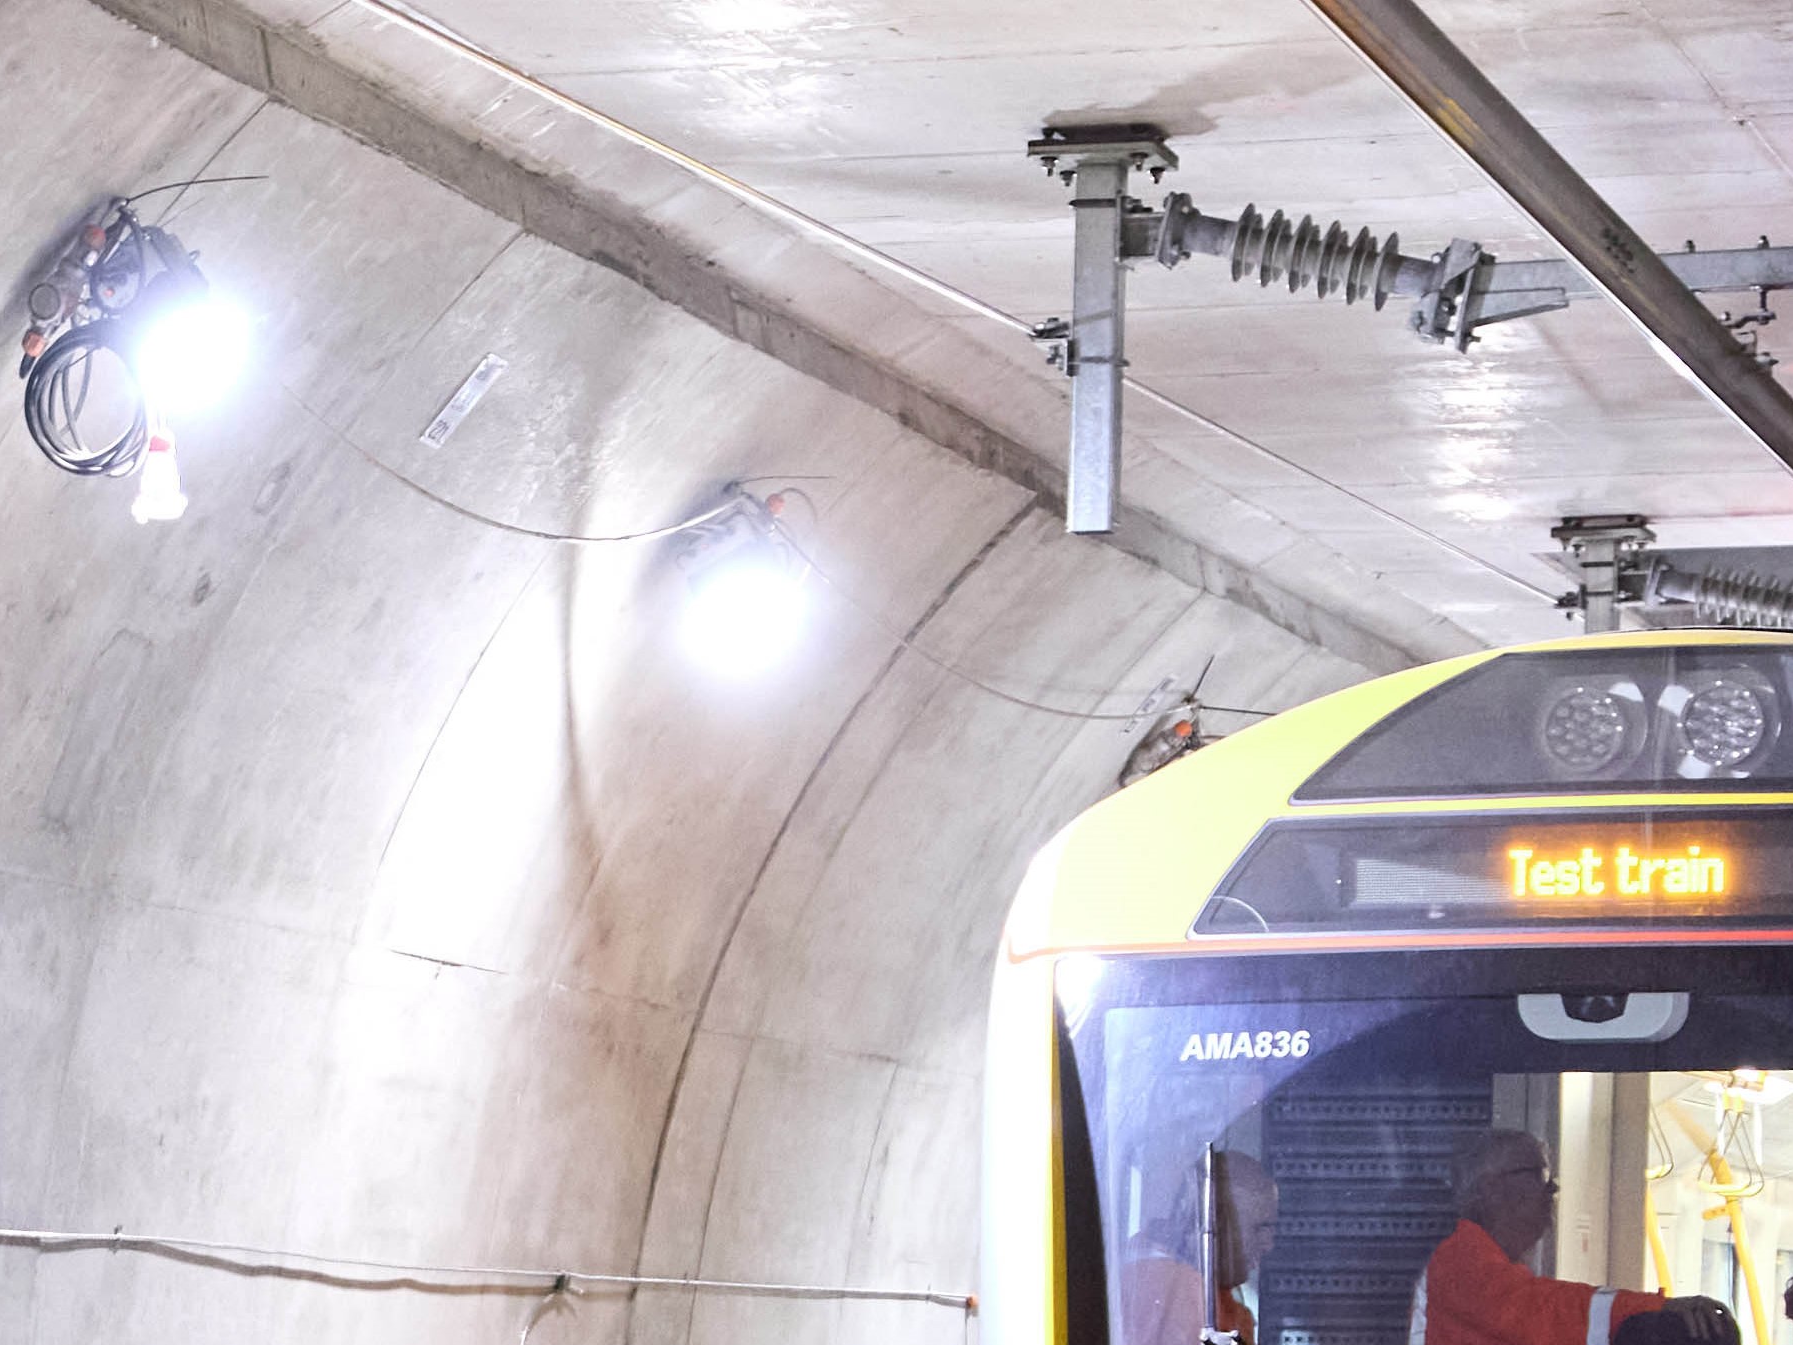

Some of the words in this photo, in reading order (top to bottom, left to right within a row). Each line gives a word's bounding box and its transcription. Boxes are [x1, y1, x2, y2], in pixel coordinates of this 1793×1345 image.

[1509, 847, 1606, 897] Test
[1615, 845, 1725, 895] train
[1179, 1030, 1311, 1062] AMA836
